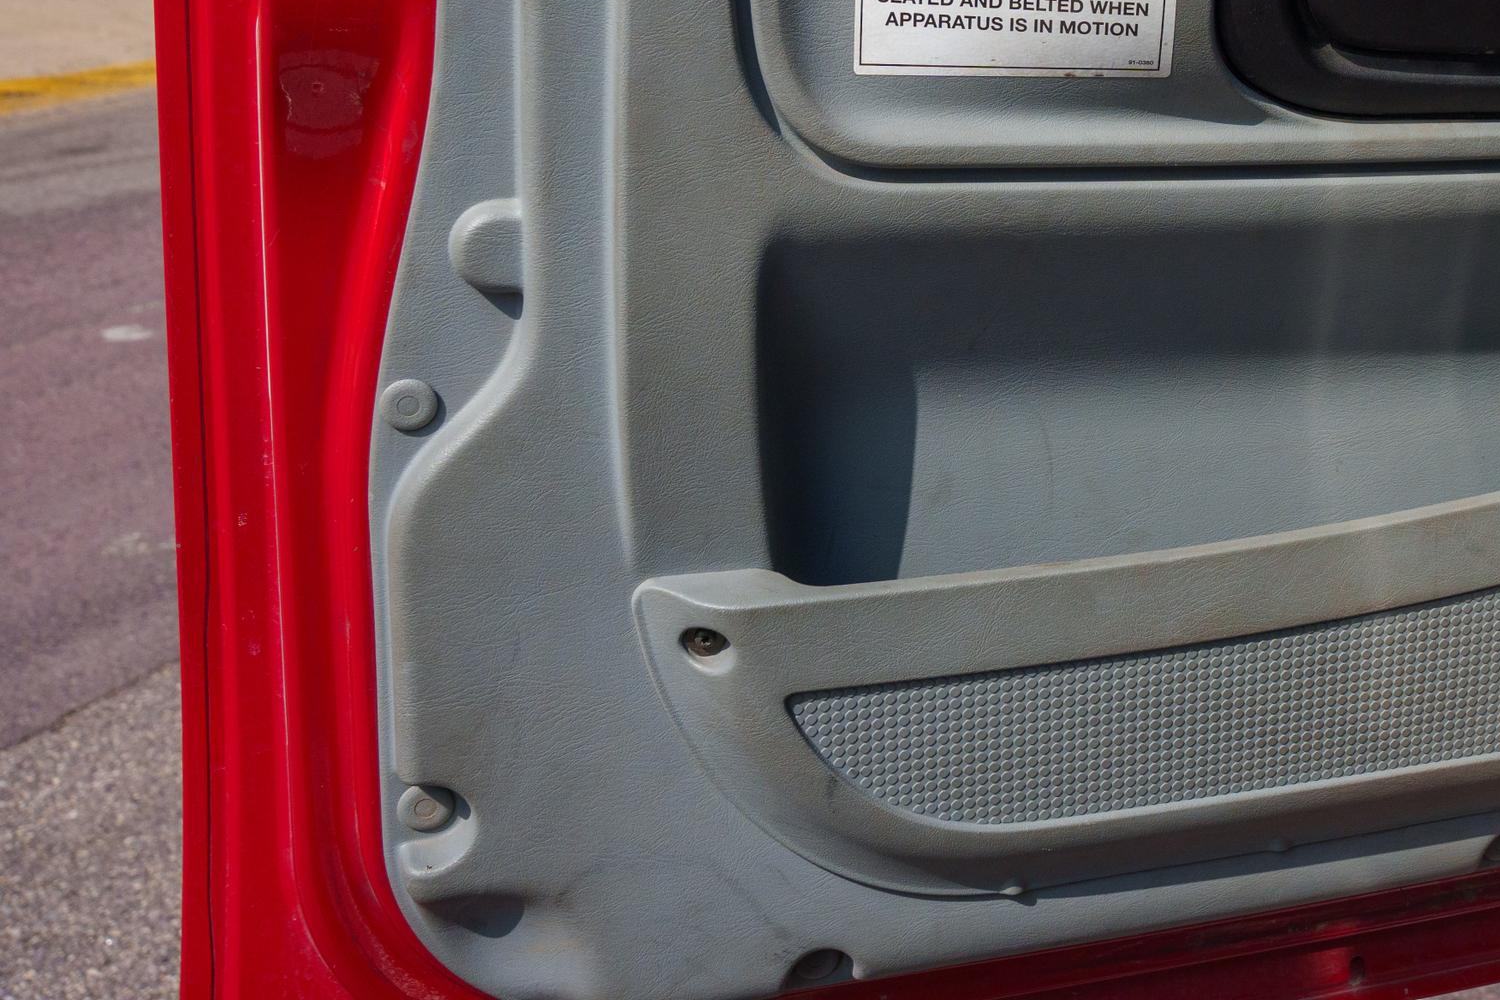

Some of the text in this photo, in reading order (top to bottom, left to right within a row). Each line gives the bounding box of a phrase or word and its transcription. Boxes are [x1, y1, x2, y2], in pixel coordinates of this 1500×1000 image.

[1090, 1, 1149, 16] WHEN
[885, 12, 1138, 36] APPARATUS IS IN MOTION
